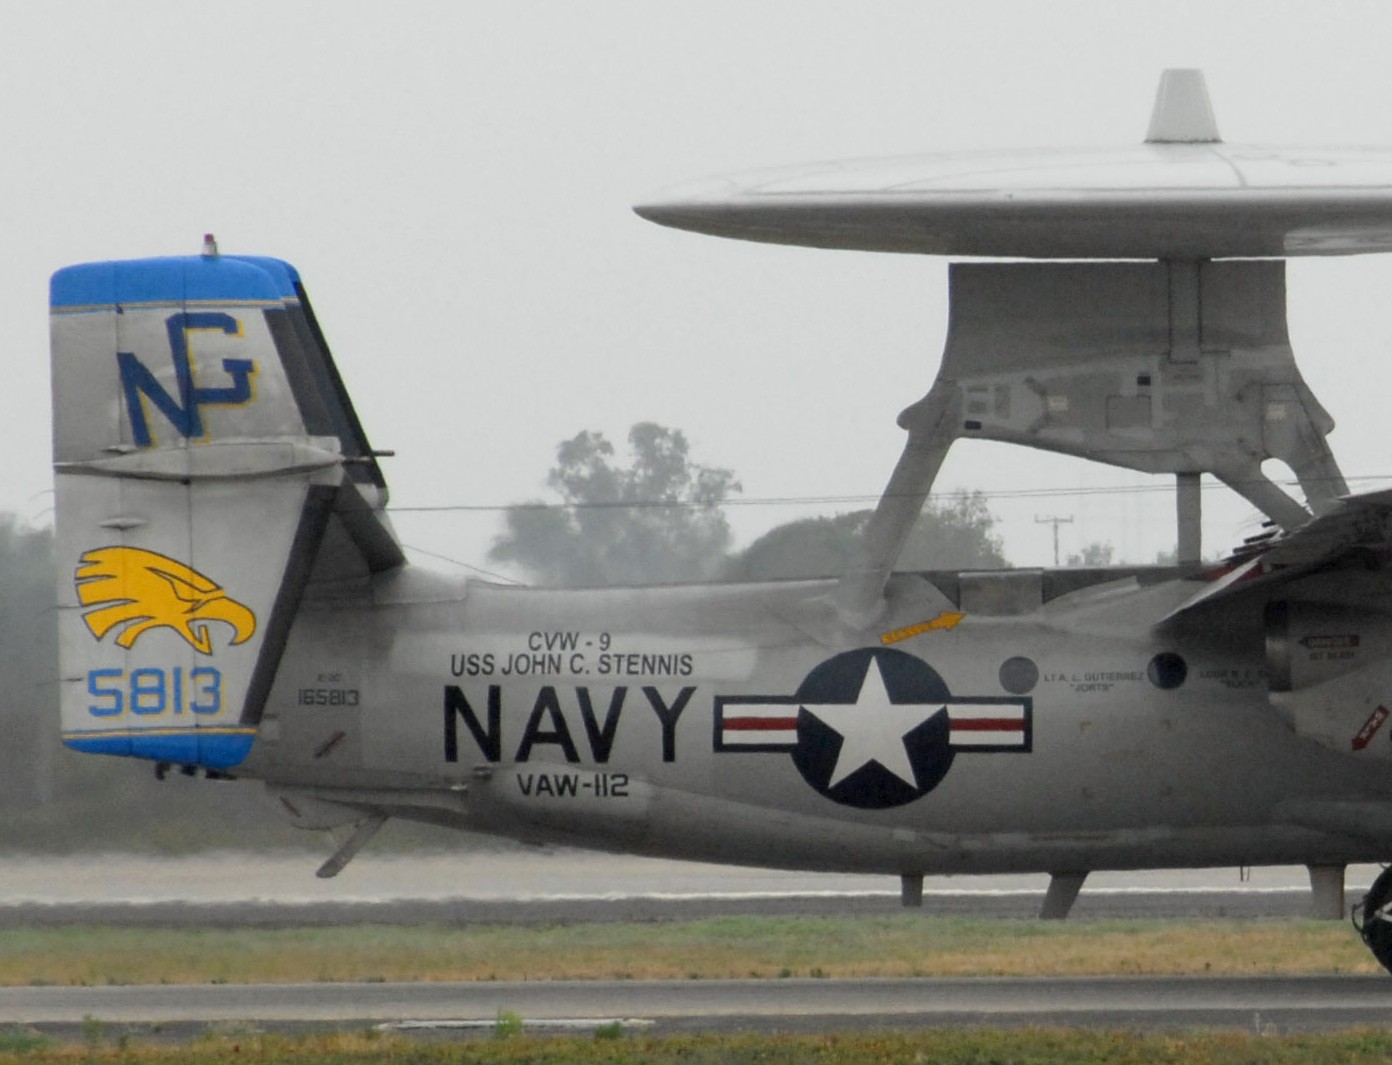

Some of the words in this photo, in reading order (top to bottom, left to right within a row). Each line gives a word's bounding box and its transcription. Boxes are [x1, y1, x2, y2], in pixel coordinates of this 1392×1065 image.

[528, 632, 579, 651] CVW
[600, 633, 612, 651] 9
[451, 654, 494, 676] USS
[502, 655, 562, 676] JOHN
[570, 655, 590, 675] C.
[598, 654, 693, 677] STENNIS
[88, 666, 227, 720] 5813
[298, 689, 359, 705] 165813
[445, 685, 698, 763] NAVY
[517, 774, 629, 797] VAW-112
